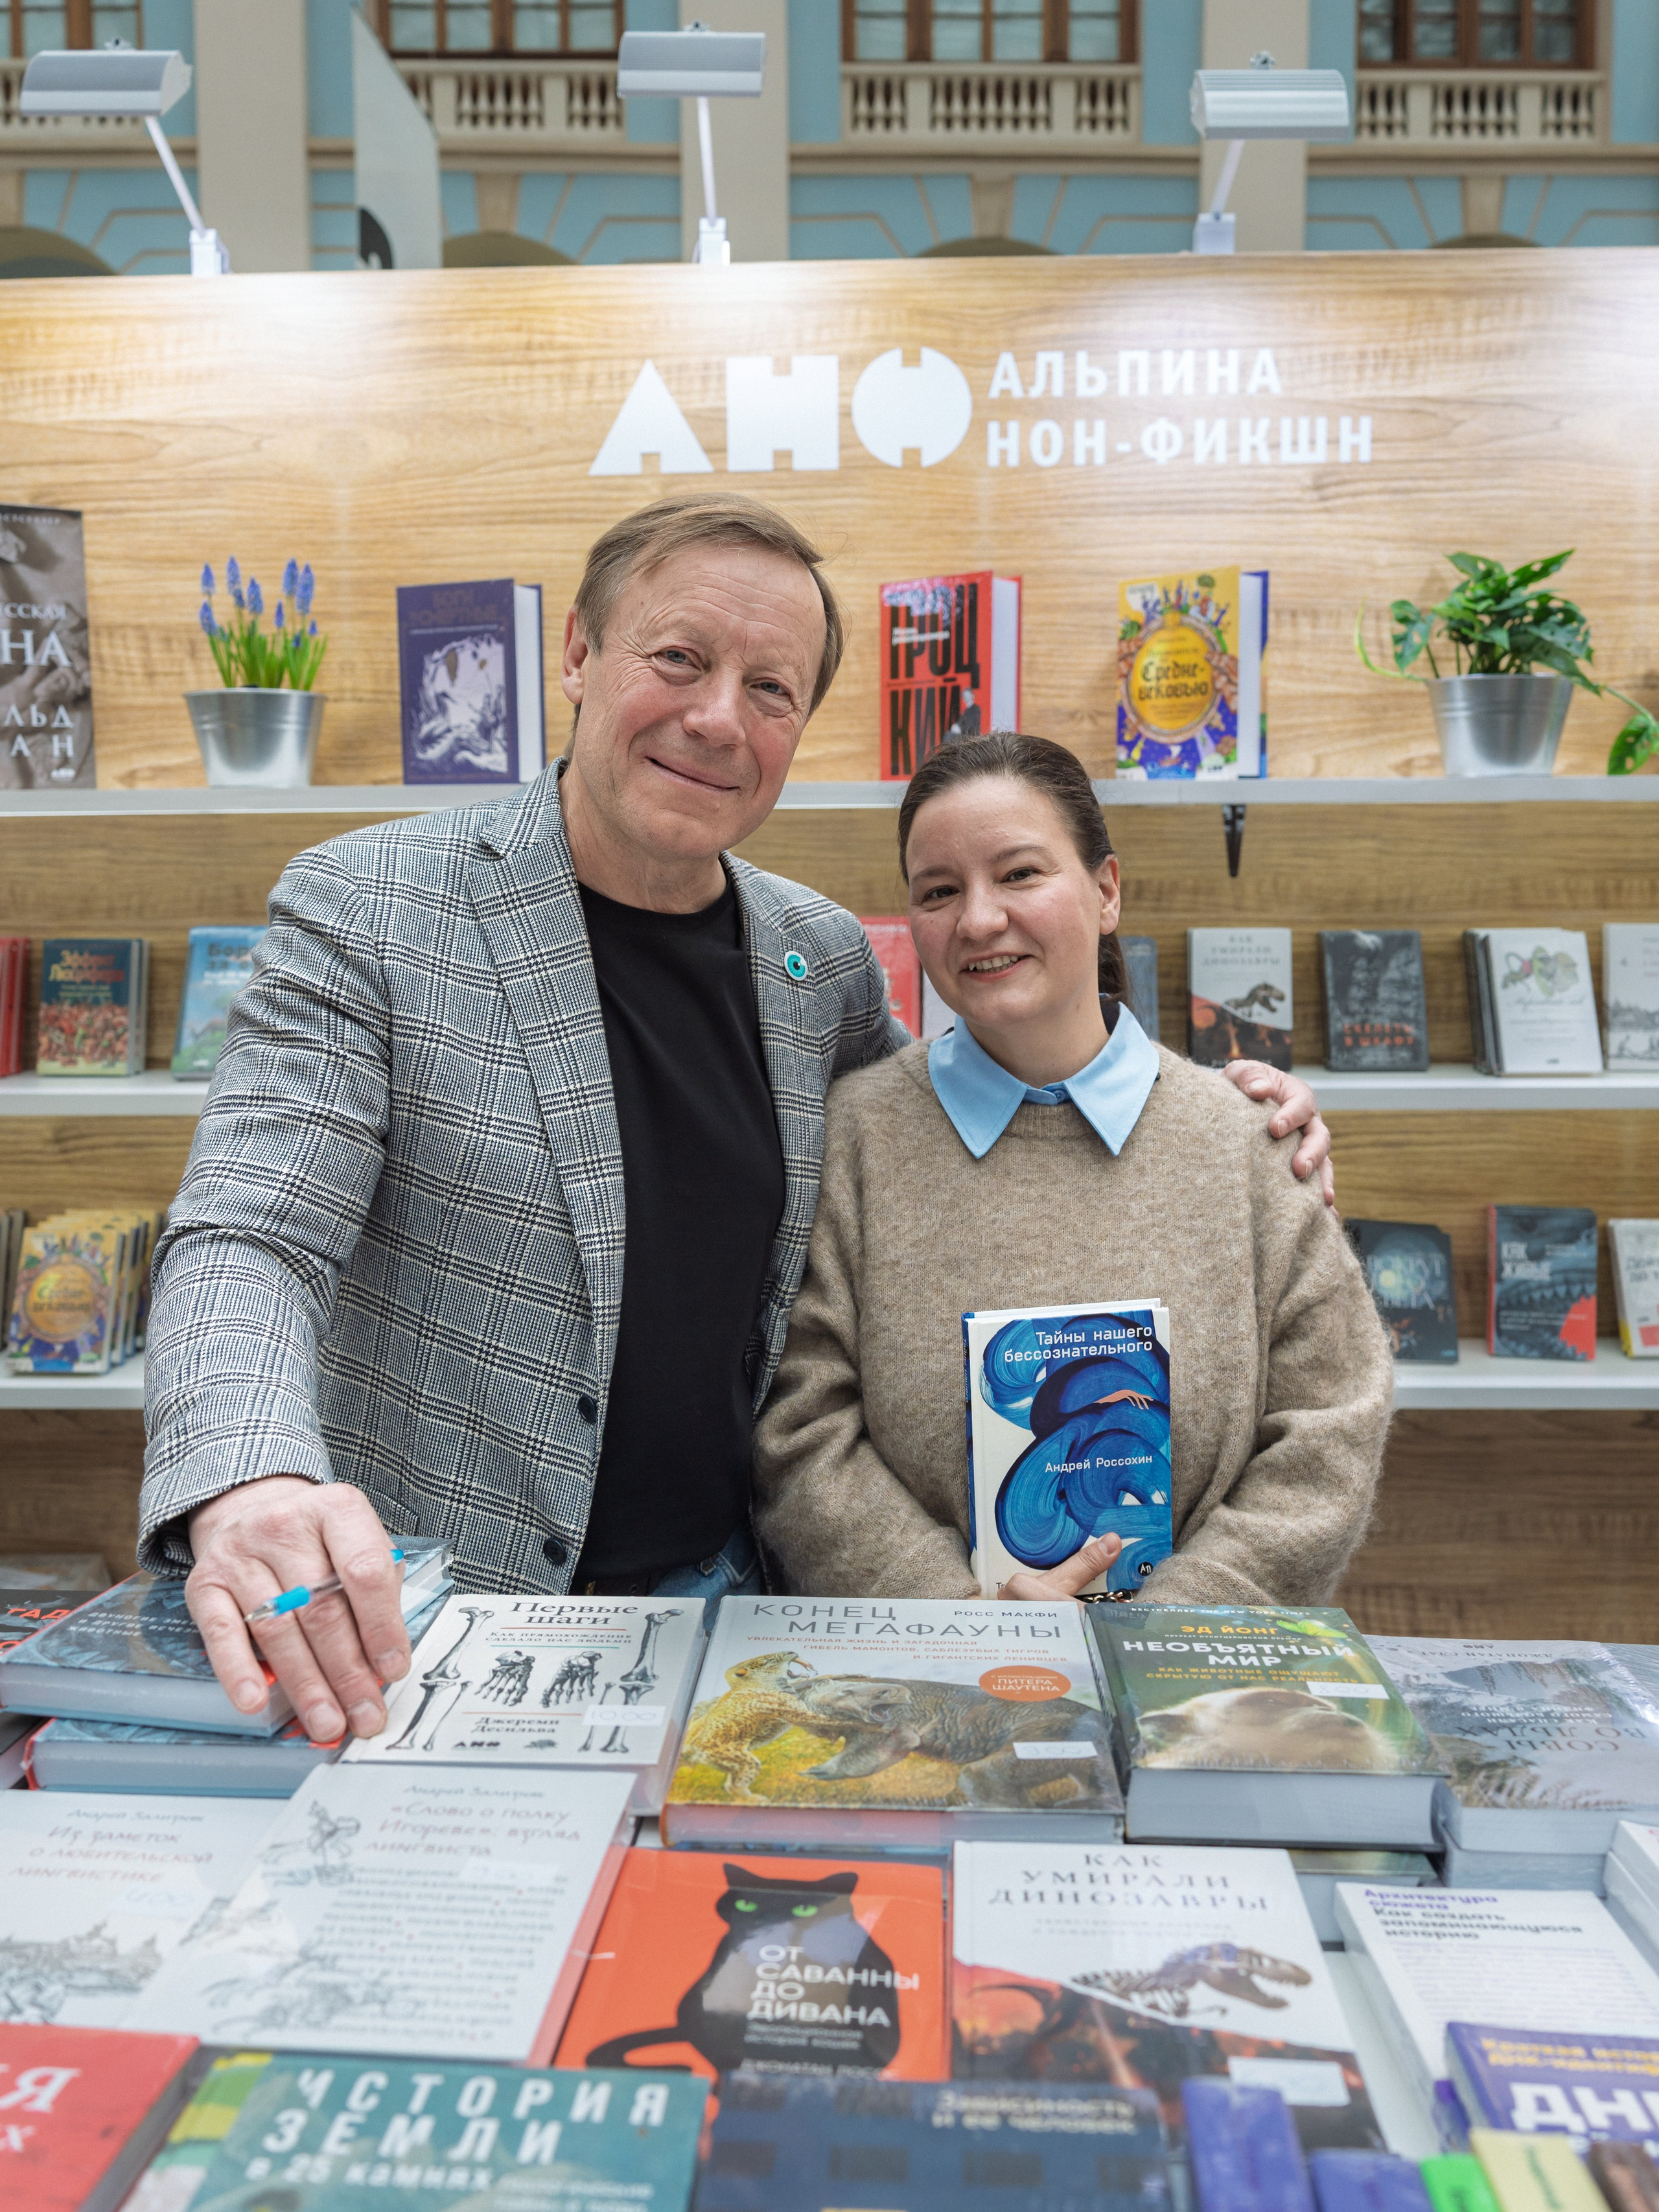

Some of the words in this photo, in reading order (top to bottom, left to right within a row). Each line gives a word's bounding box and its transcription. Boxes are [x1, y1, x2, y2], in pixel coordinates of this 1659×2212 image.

[988, 347, 1282, 399] АЛЬПИНА
[988, 415, 1371, 468] НОН-ФИКШН
[1036, 1330, 1085, 1346] Тайны
[1093, 1326, 1153, 1342] нашего
[1004, 1340, 1153, 1363] бессознательного
[1045, 1458, 1091, 1474] Андрей
[1096, 1454, 1153, 1469] Россохин
[509, 1601, 639, 1616] Первые
[753, 1603, 897, 1621] КОНЕЦ
[88, 1611, 157, 1623] ДВУНОГИЕ
[91, 1619, 142, 1629] ДРУГИЕ
[524, 1614, 612, 1625] шаги
[69, 1625, 142, 1636] ЖИВОТНЫЕ
[788, 1620, 1062, 1638] МЕГАФАУНЫ
[1180, 1625, 1212, 1635] ЭД
[1220, 1624, 1279, 1635] ЙОНГ
[923, 1646, 1001, 1655] САБЛЕЗУБЫХ
[1123, 1640, 1355, 1657] НЕОБЪЯТНЫЙ
[1208, 1655, 1282, 1667] МИР
[1268, 1669, 1340, 1677] ОЩУЩАЮТ
[472, 1724, 556, 1733] Десильва
[477, 1716, 560, 1726] Джереми
[1454, 1725, 1577, 1738] ЛЬДАХ
[1595, 1727, 1646, 1738] ВО
[1504, 1740, 1619, 1752] СОВЫ
[1084, 1852, 1165, 1867] КАК
[1022, 1869, 1230, 1889] УМИРАЛИ
[988, 1889, 1268, 1911] ДИНОЗАВРЫ
[1363, 1889, 1498, 1904] Архитектура
[1373, 1907, 1413, 1918] Как
[1421, 1911, 1505, 1921] создать
[1380, 1918, 1583, 1934] запоминающуюся
[1385, 1929, 1479, 1940] историю
[759, 1944, 804, 1962] ОТ
[755, 1962, 920, 1990] САВАННЫ
[750, 1981, 805, 2001] ДО
[747, 2001, 890, 2027] ДИВАНА
[262, 2108, 563, 2166] ЗЕМЛИ
